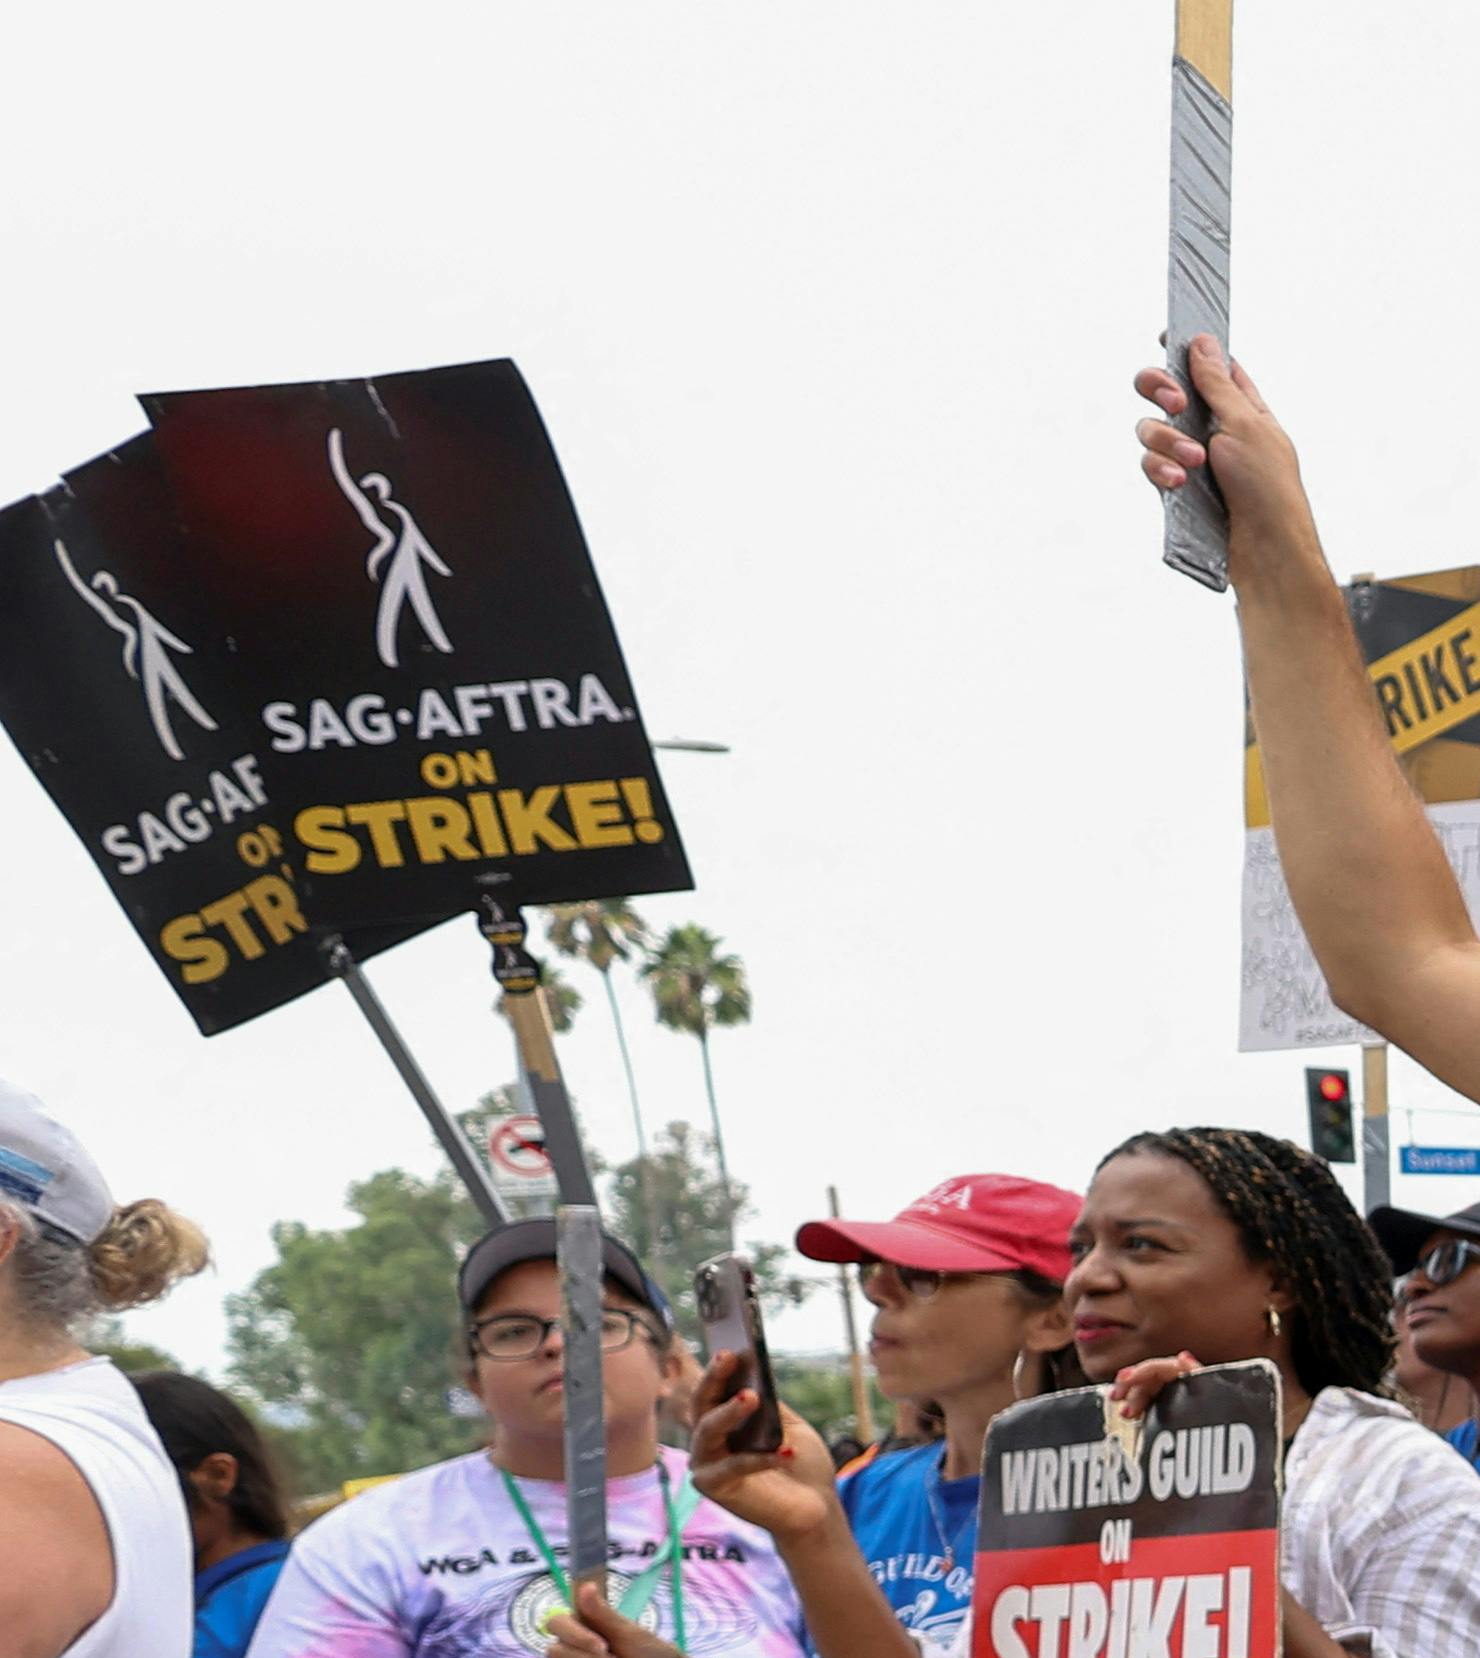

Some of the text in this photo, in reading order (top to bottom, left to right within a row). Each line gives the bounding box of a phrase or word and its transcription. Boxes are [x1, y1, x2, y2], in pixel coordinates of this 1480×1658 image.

[421, 748, 498, 790] ON
[294, 778, 665, 875] STRIKE!
[1001, 1421, 1255, 1516] WRITERS GUILD
[419, 1549, 499, 1577] WGA
[1099, 1518, 1132, 1567] ON
